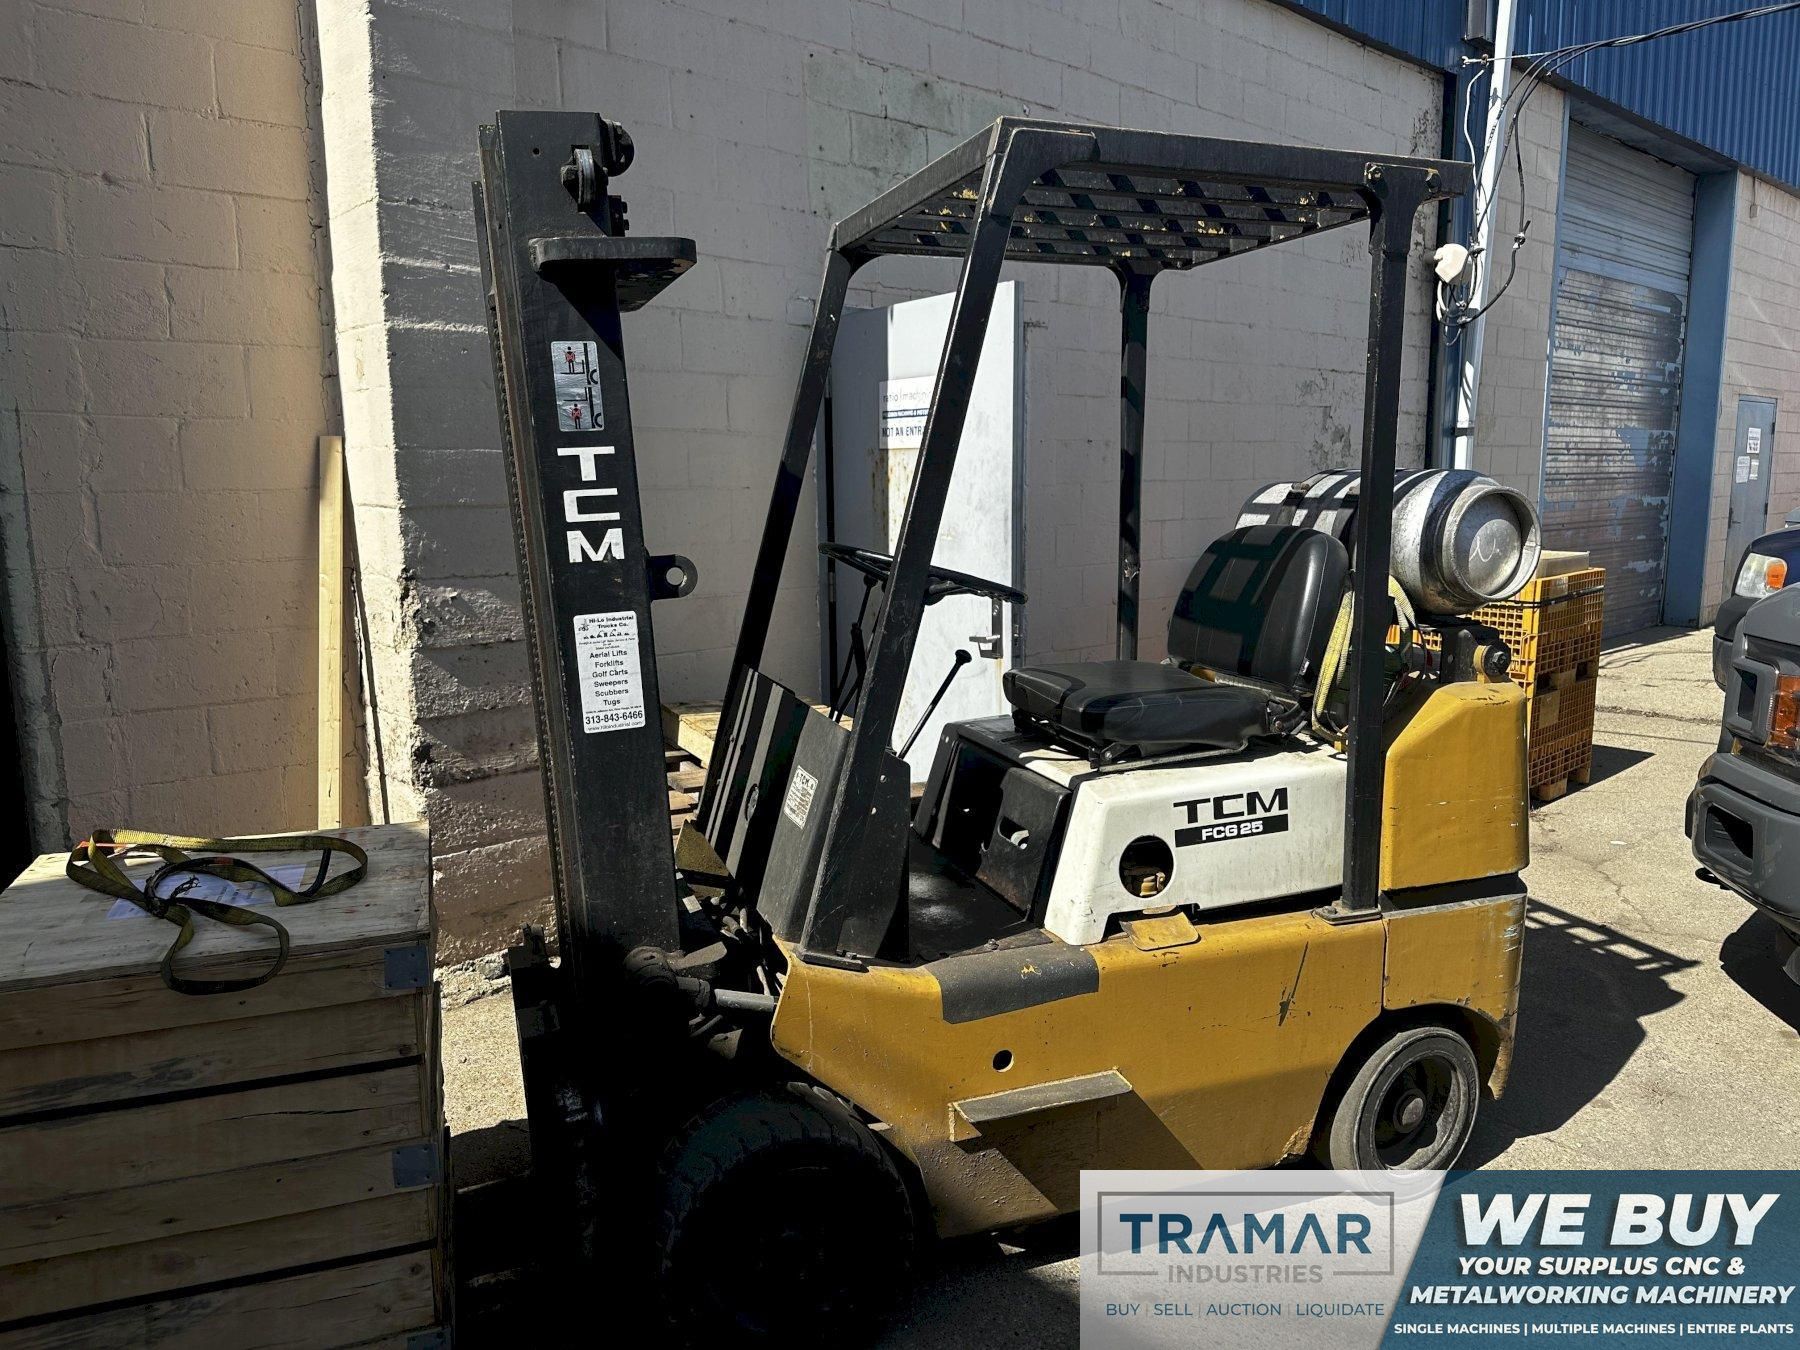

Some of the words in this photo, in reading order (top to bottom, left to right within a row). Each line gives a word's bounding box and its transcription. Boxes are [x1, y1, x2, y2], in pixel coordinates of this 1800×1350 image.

[882, 427, 894, 437] NOT
[896, 427, 903, 436] AN
[906, 425, 926, 436] ENTR
[557, 446, 625, 563] TCM
[590, 651, 610, 659] Aerial
[612, 649, 628, 657] Lifts
[594, 660, 624, 668] Forklifts
[593, 679, 629, 687] Sweepers
[594, 688, 629, 697] Scubbers
[585, 710, 643, 725] 313-843-6466
[1173, 787, 1289, 824] TCM
[1201, 824, 1239, 841] FCG
[1240, 820, 1264, 835] 25
